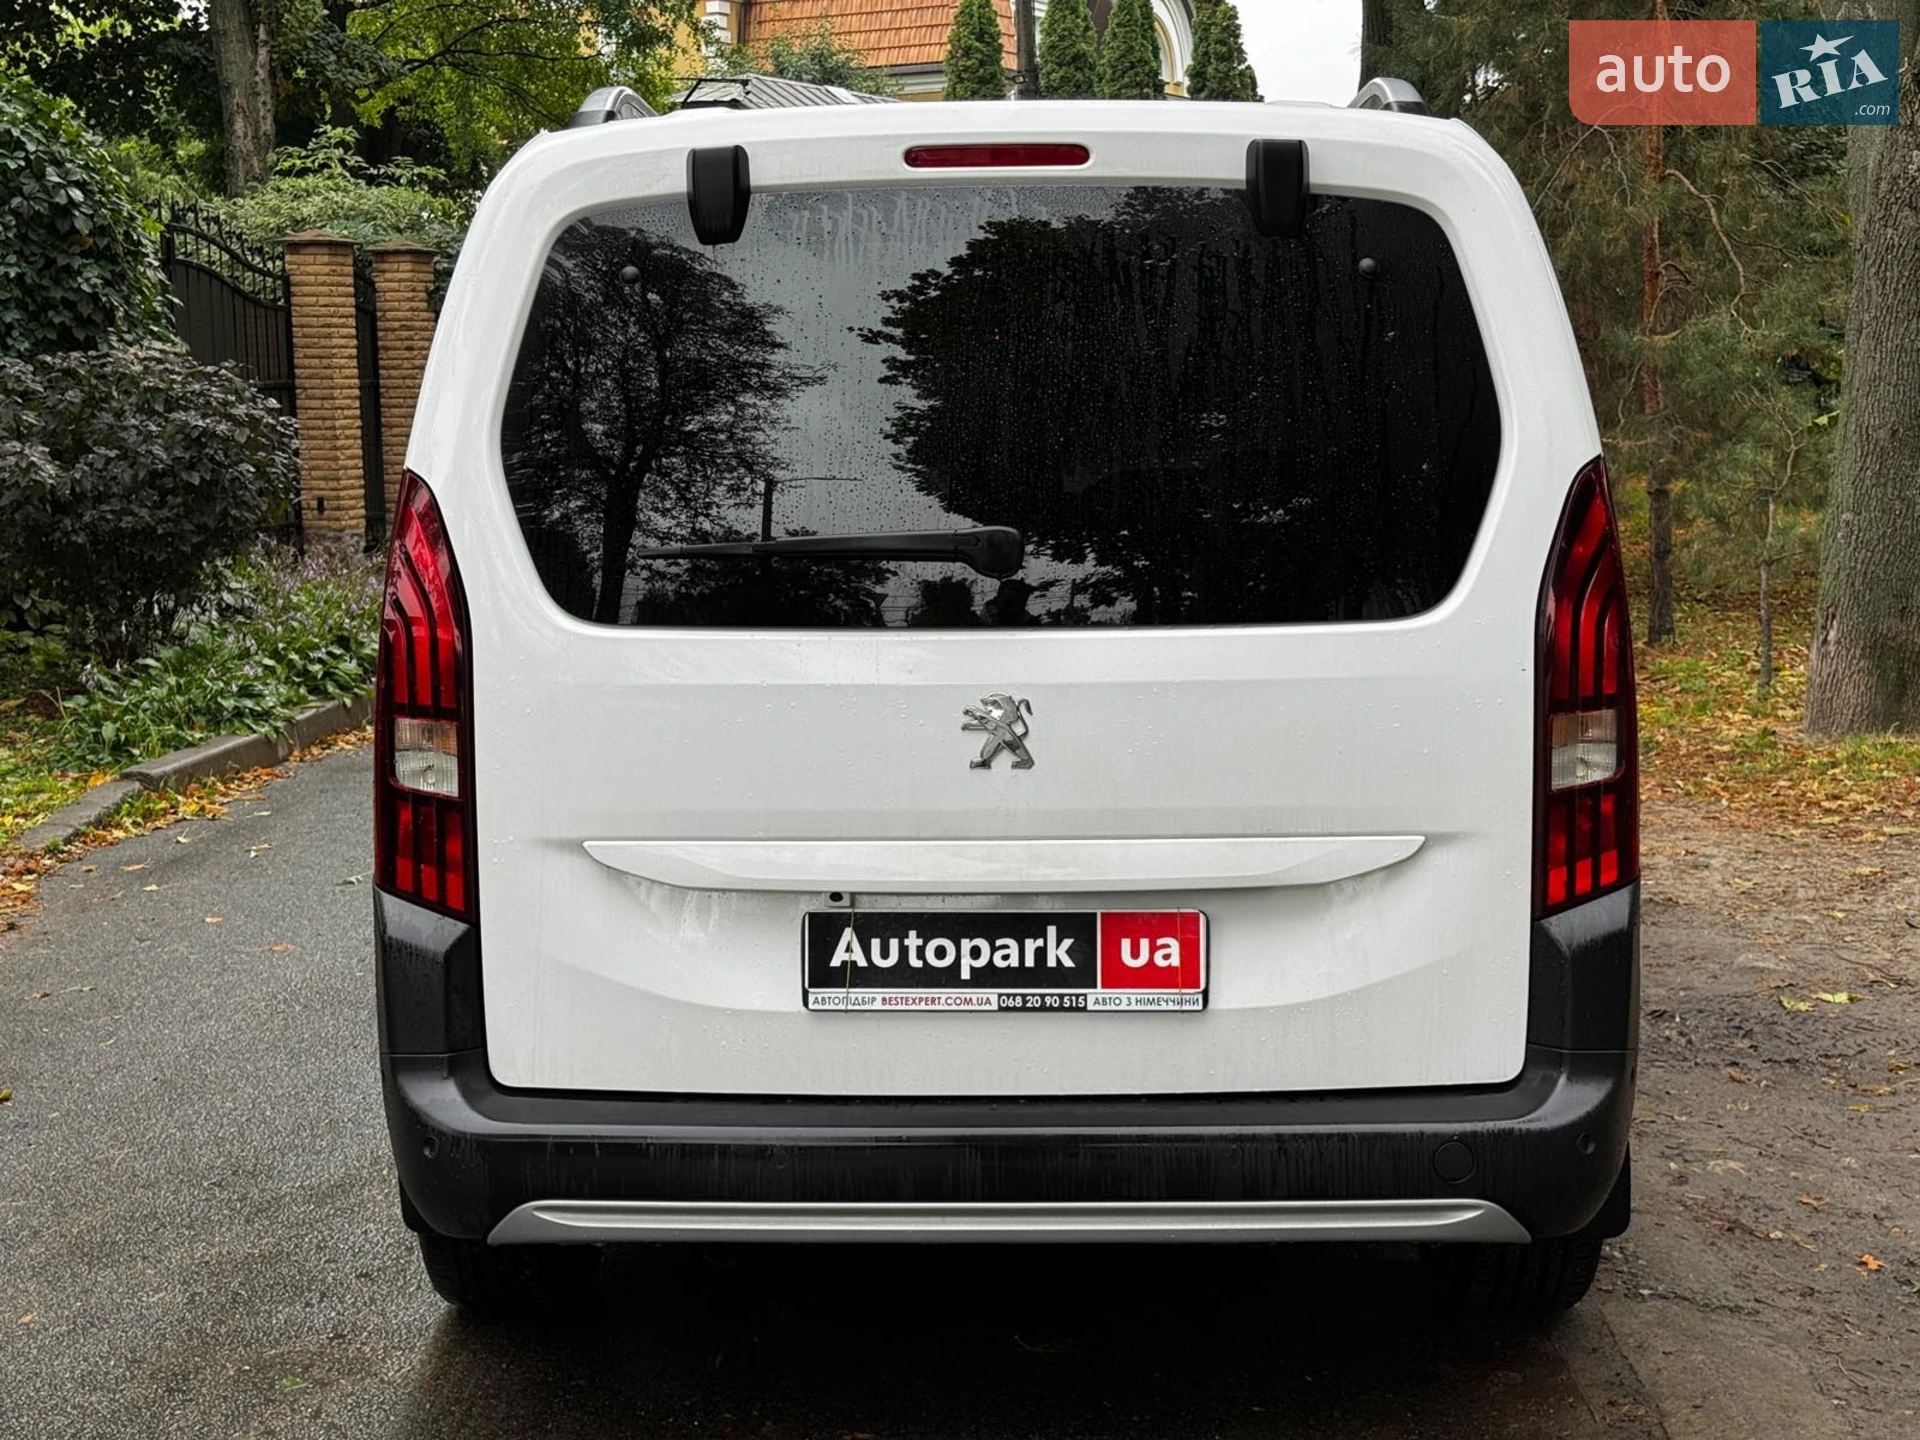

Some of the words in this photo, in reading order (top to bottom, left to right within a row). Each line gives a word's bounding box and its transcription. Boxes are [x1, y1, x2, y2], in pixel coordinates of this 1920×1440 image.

[829, 925, 1076, 980] Autopark
[1120, 936, 1180, 968] ua
[881, 994, 992, 1007] BESTEXPERT.COM.UA
[1000, 995, 1022, 1008] 068
[1026, 995, 1041, 1008] 20
[1044, 995, 1059, 1008] 90
[1063, 995, 1086, 1008] 515
[1093, 994, 1122, 1007] АВТО
[1135, 994, 1200, 1007] НІМЕЧЧИНИ
